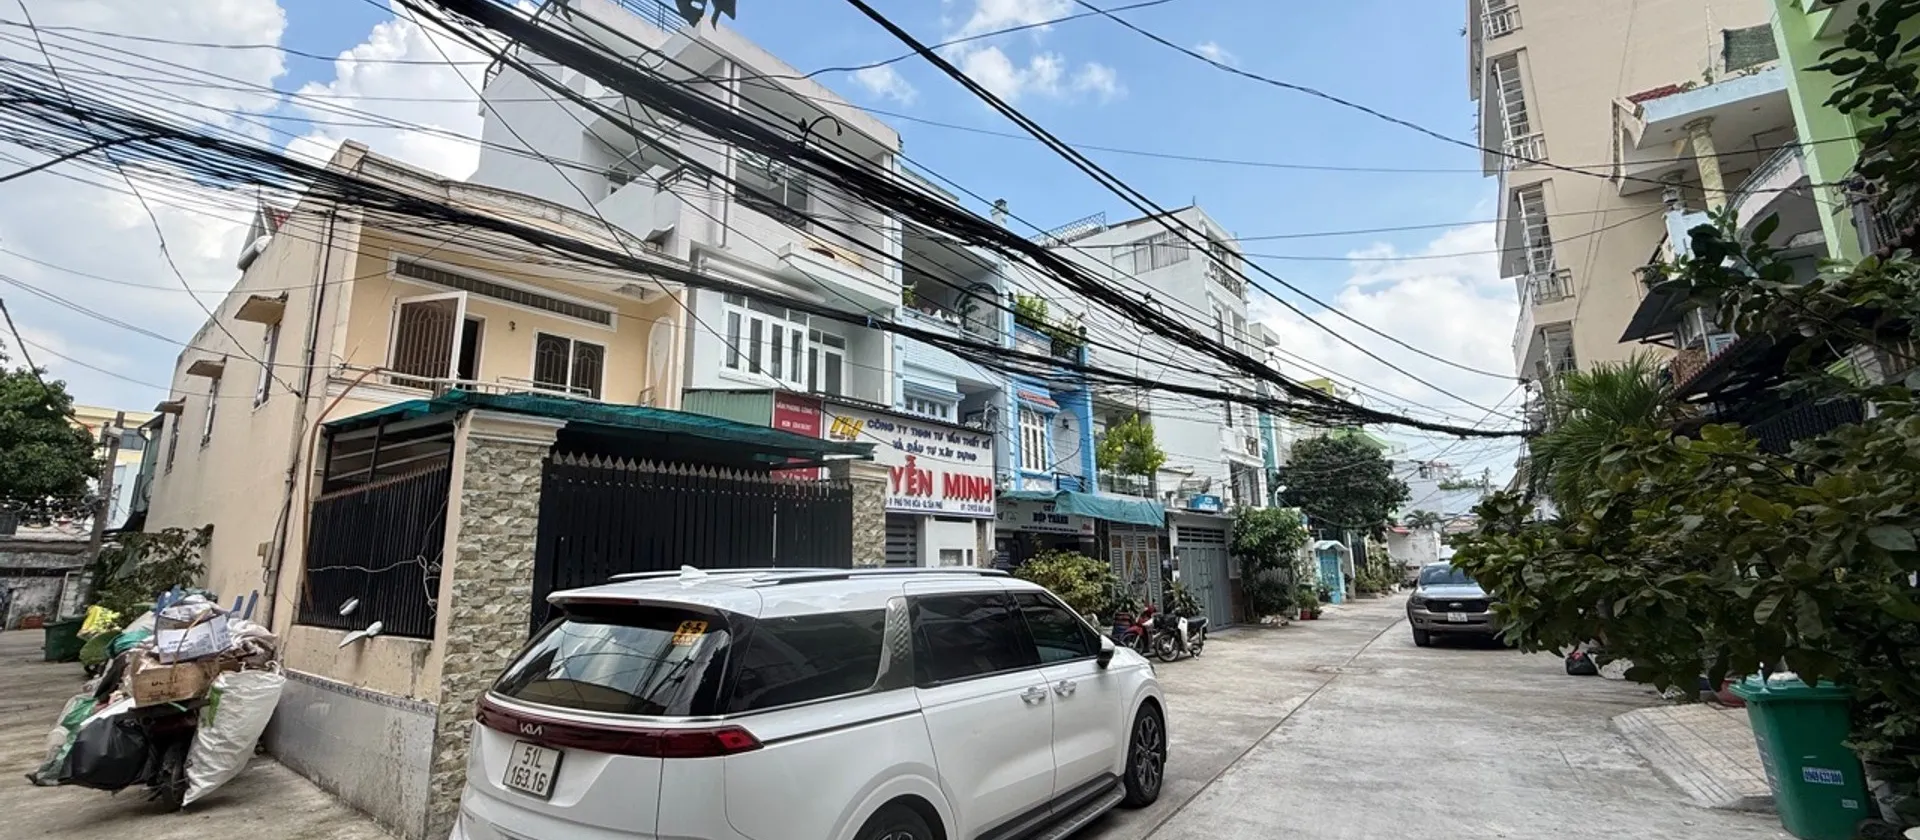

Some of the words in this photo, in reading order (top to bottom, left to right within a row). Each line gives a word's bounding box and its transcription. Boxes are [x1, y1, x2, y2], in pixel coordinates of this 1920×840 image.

[867, 418, 895, 432] CÔNG
[897, 424, 908, 434] TY
[910, 427, 931, 439] TNHH
[933, 430, 944, 441] TƯ
[893, 438, 905, 450] VÀ
[942, 472, 992, 503] MINH
[520, 723, 543, 736] KIA
[522, 746, 543, 768] 51L
[510, 766, 547, 792] 163.16
